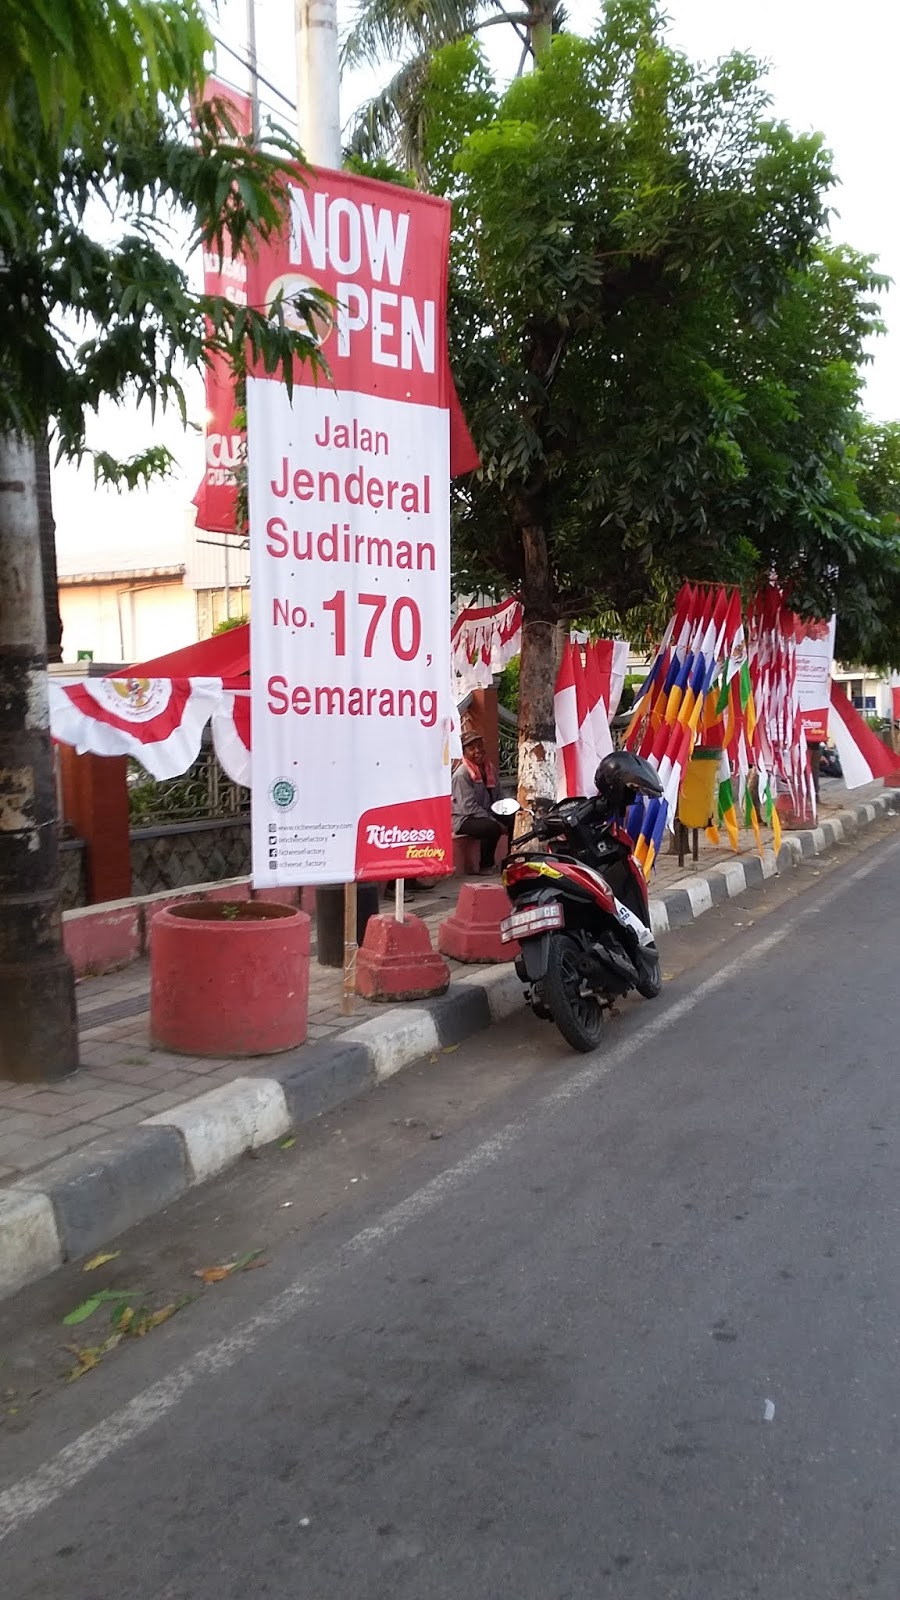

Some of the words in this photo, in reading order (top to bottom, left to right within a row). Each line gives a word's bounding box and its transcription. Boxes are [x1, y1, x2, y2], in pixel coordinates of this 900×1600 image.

[288, 185, 410, 286] NOW
[315, 416, 389, 455] Jalan
[270, 457, 431, 514] Jenderal
[266, 517, 436, 571] Sudirman
[272, 598, 315, 628] No.
[323, 590, 433, 667] 170,
[267, 675, 438, 727] Semarang
[366, 824, 435, 849] Richeese
[406, 845, 445, 861] Factory
